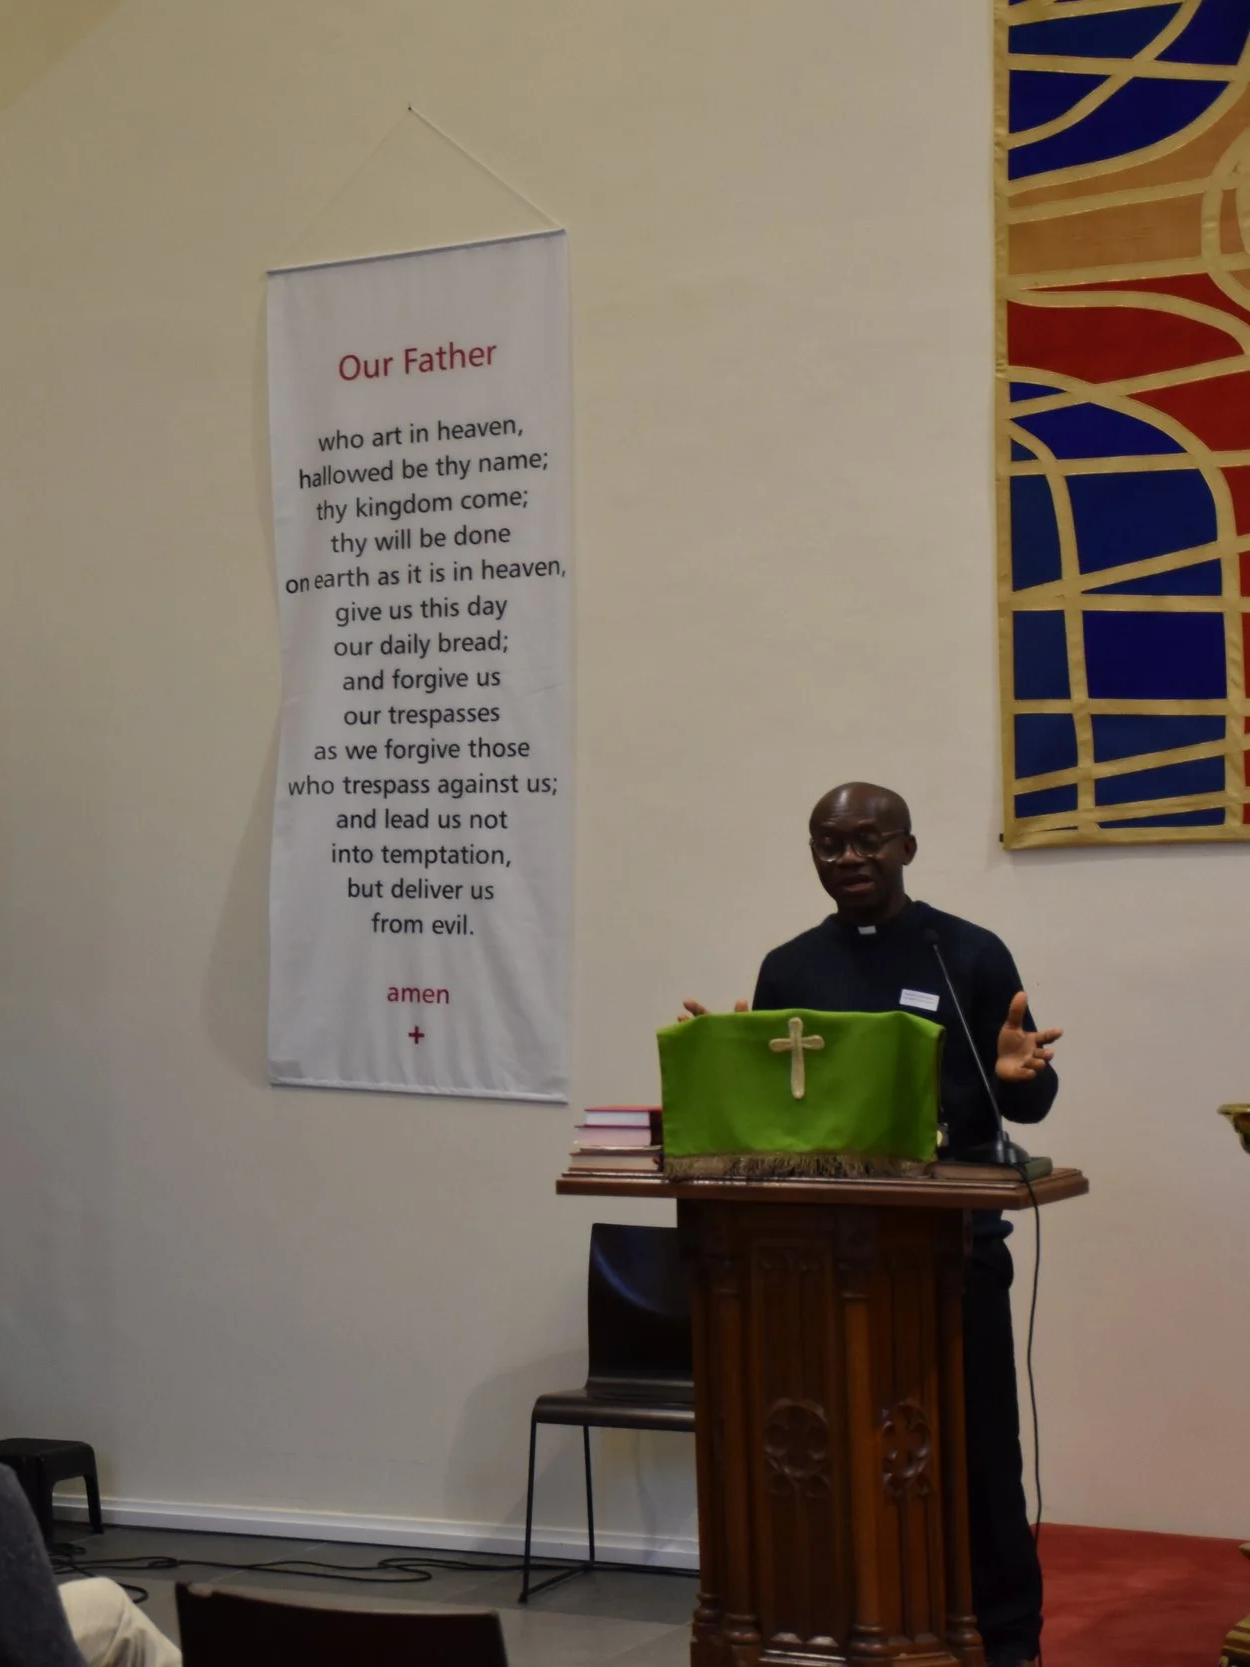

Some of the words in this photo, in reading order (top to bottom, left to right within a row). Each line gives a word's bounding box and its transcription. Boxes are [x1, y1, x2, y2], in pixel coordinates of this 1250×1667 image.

[338, 354, 395, 382] Our
[403, 341, 498, 375] Father
[317, 429, 365, 453] who
[371, 426, 403, 448] art
[409, 422, 429, 444] in
[437, 418, 524, 441] heaven,
[298, 459, 394, 490] hallowed
[401, 458, 429, 480] be
[434, 454, 472, 481] thy
[478, 452, 549, 473] name;
[315, 499, 348, 525] thy
[355, 492, 453, 521] kingdom
[460, 489, 528, 510] come;
[330, 531, 368, 558] thy
[373, 528, 412, 552] will
[419, 527, 447, 549] be
[453, 524, 512, 547] done
[285, 577, 310, 595] on
[313, 565, 370, 590] earth
[377, 570, 401, 587] as
[407, 563, 423, 585] it
[429, 561, 446, 583] is
[453, 560, 474, 582] in
[481, 558, 566, 581] heaven,
[335, 601, 383, 628] give
[388, 604, 414, 621] us
[419, 596, 460, 619] this
[466, 594, 508, 621] day
[333, 640, 374, 657] our
[379, 632, 431, 660] daily
[437, 628, 509, 654] bread;
[342, 668, 385, 691] and
[391, 667, 469, 695] forgive
[476, 670, 501, 688] us
[343, 709, 382, 726] our
[387, 706, 501, 729] trespasses
[313, 745, 338, 761] as
[344, 744, 378, 761] we
[383, 737, 461, 765] forgive
[467, 736, 531, 759] those
[288, 774, 335, 797] who
[341, 775, 431, 800] trespass
[437, 772, 520, 800] against
[526, 777, 558, 797] us;
[335, 807, 377, 830] and
[384, 807, 430, 830] lead
[437, 813, 462, 830] us
[469, 810, 509, 830] not
[331, 842, 375, 864] into
[380, 843, 511, 870] temptation,
[347, 876, 384, 899] but
[390, 877, 464, 900] deliver
[470, 884, 495, 901] us
[370, 911, 424, 935] from
[431, 913, 474, 936] evil.
[386, 986, 450, 1005] amen
